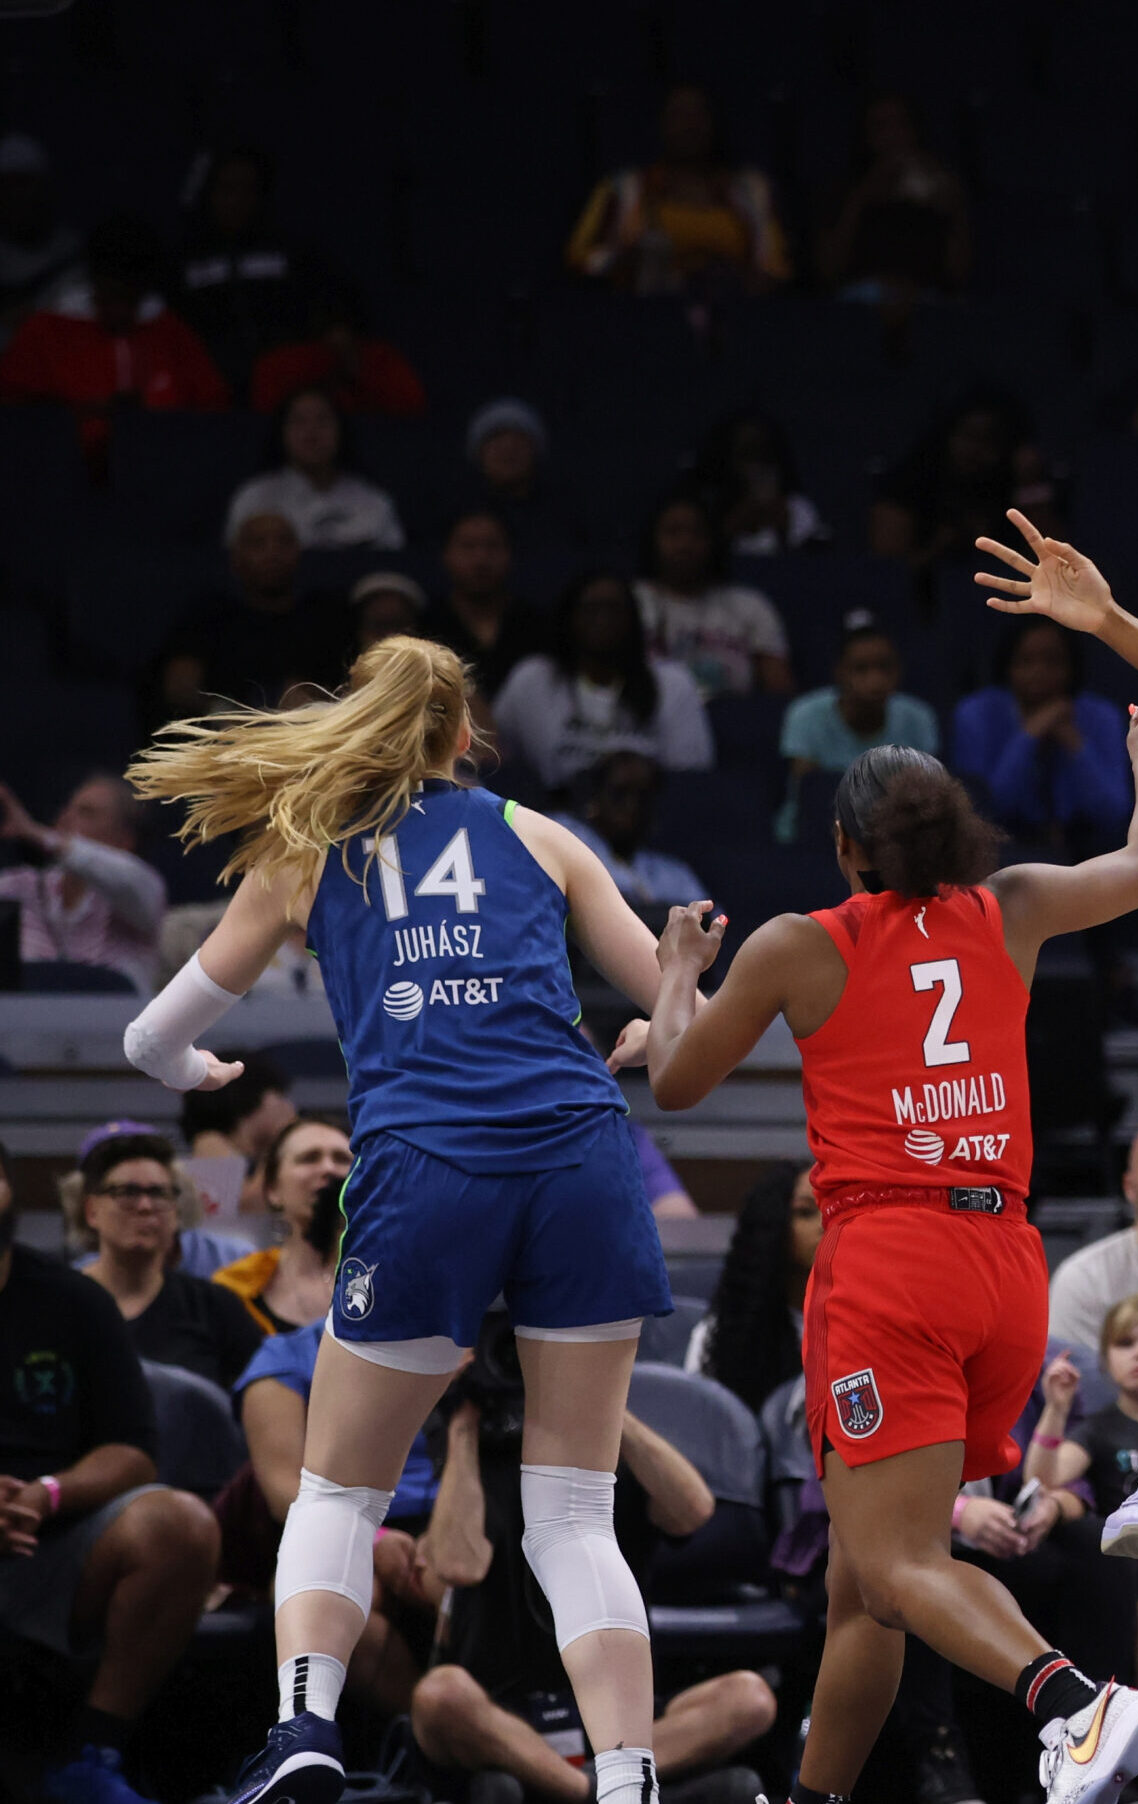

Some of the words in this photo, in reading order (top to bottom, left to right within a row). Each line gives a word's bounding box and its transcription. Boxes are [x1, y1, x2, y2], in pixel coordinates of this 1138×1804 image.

[361, 827, 486, 922] 14
[393, 919, 484, 967] JUHÁSZ
[430, 978, 503, 1005] AT&T
[910, 957, 972, 1068] 2
[892, 1073, 1006, 1125] McDONALD
[948, 1133, 1011, 1162] AT&T
[835, 1375, 870, 1395] ATLANTA
